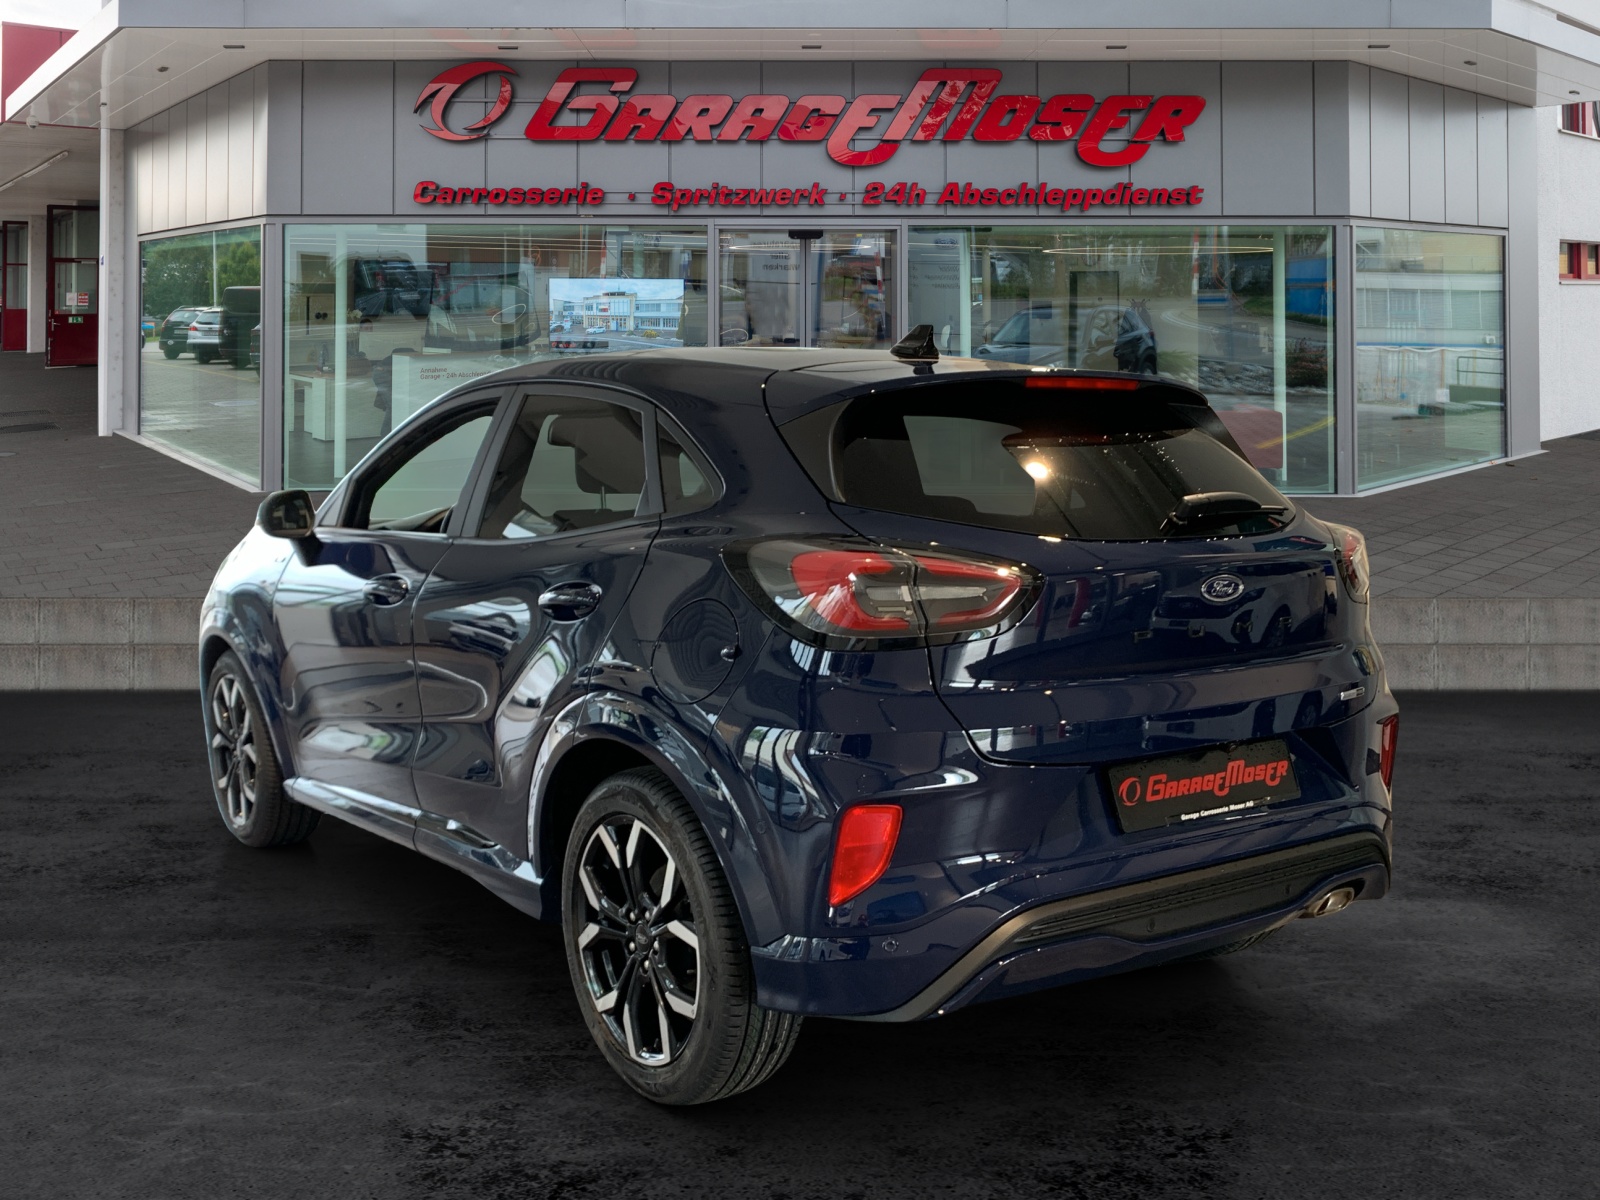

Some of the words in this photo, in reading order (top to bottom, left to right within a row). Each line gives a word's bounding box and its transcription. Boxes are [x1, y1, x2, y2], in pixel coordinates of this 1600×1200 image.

[413, 180, 604, 205] Carrosserie
[651, 181, 827, 211] Spritzwerk
[862, 181, 927, 205] 24h
[937, 181, 1205, 212] Abschleppdienst
